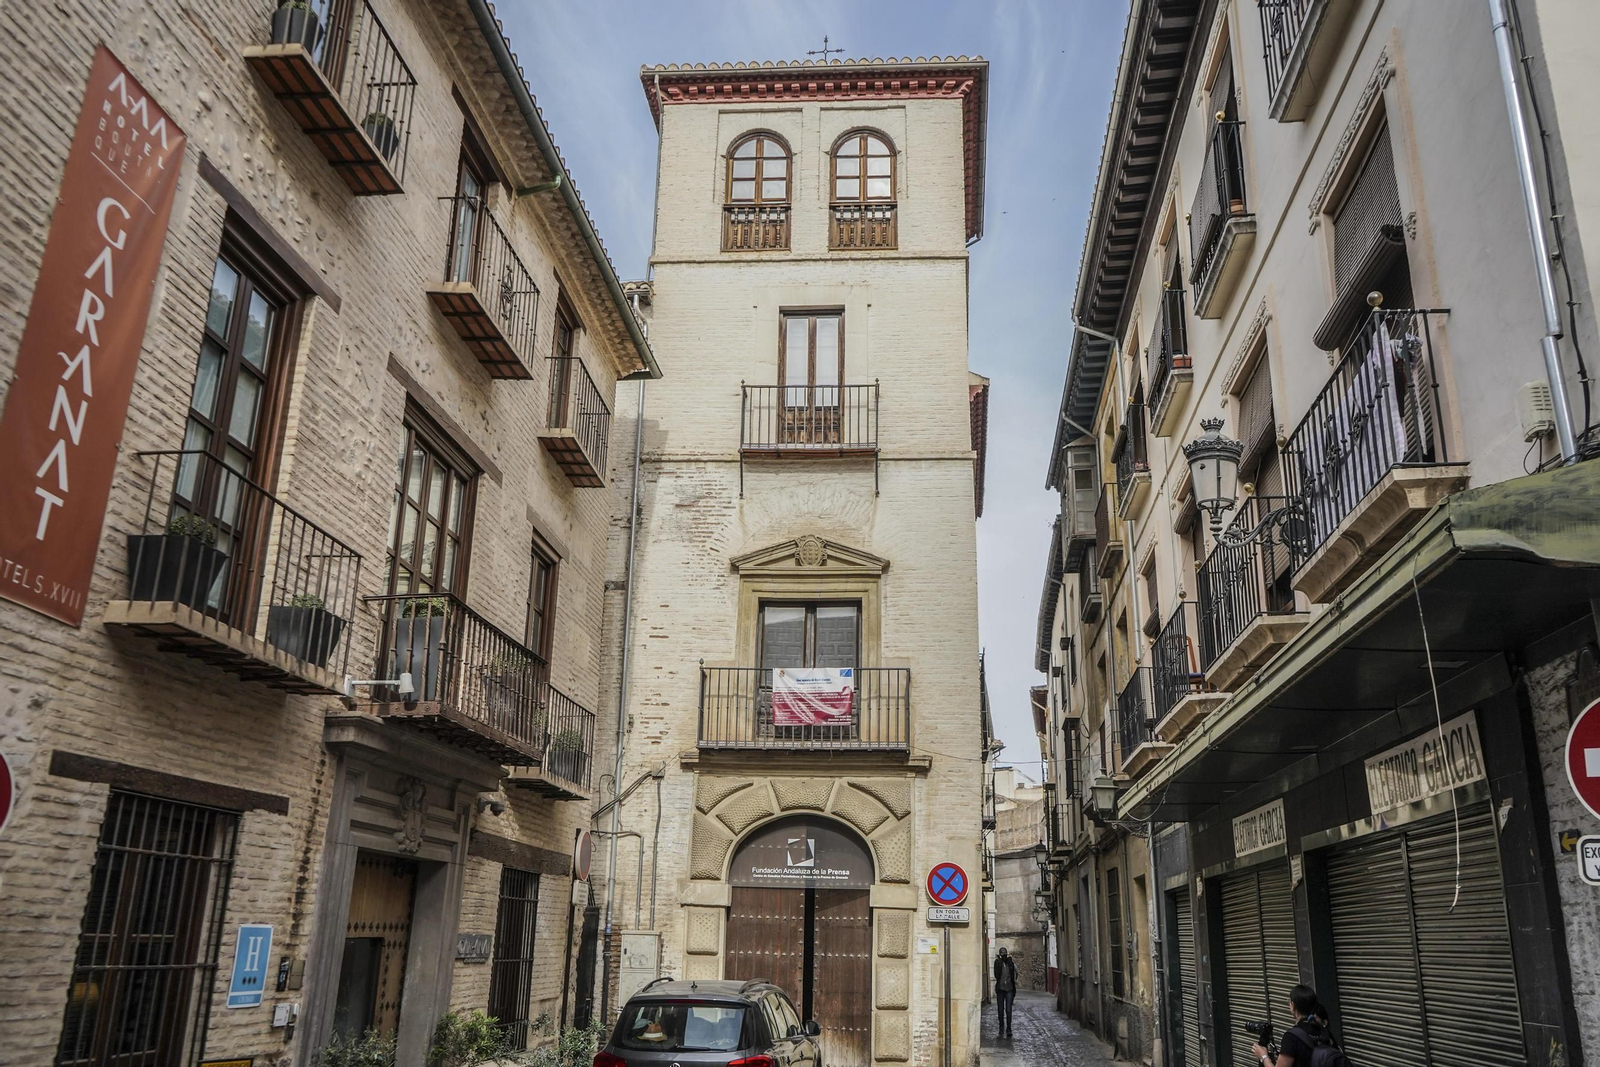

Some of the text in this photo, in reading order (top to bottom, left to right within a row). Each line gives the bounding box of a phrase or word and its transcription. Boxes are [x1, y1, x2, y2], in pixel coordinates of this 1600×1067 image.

[94, 135, 128, 174] QUE
[102, 99, 165, 170] HOTEL
[36, 196, 131, 542] GARANAT
[1422, 723, 1483, 793] GARCIA
[1259, 805, 1286, 846] GARCIA
[243, 937, 263, 972] H
